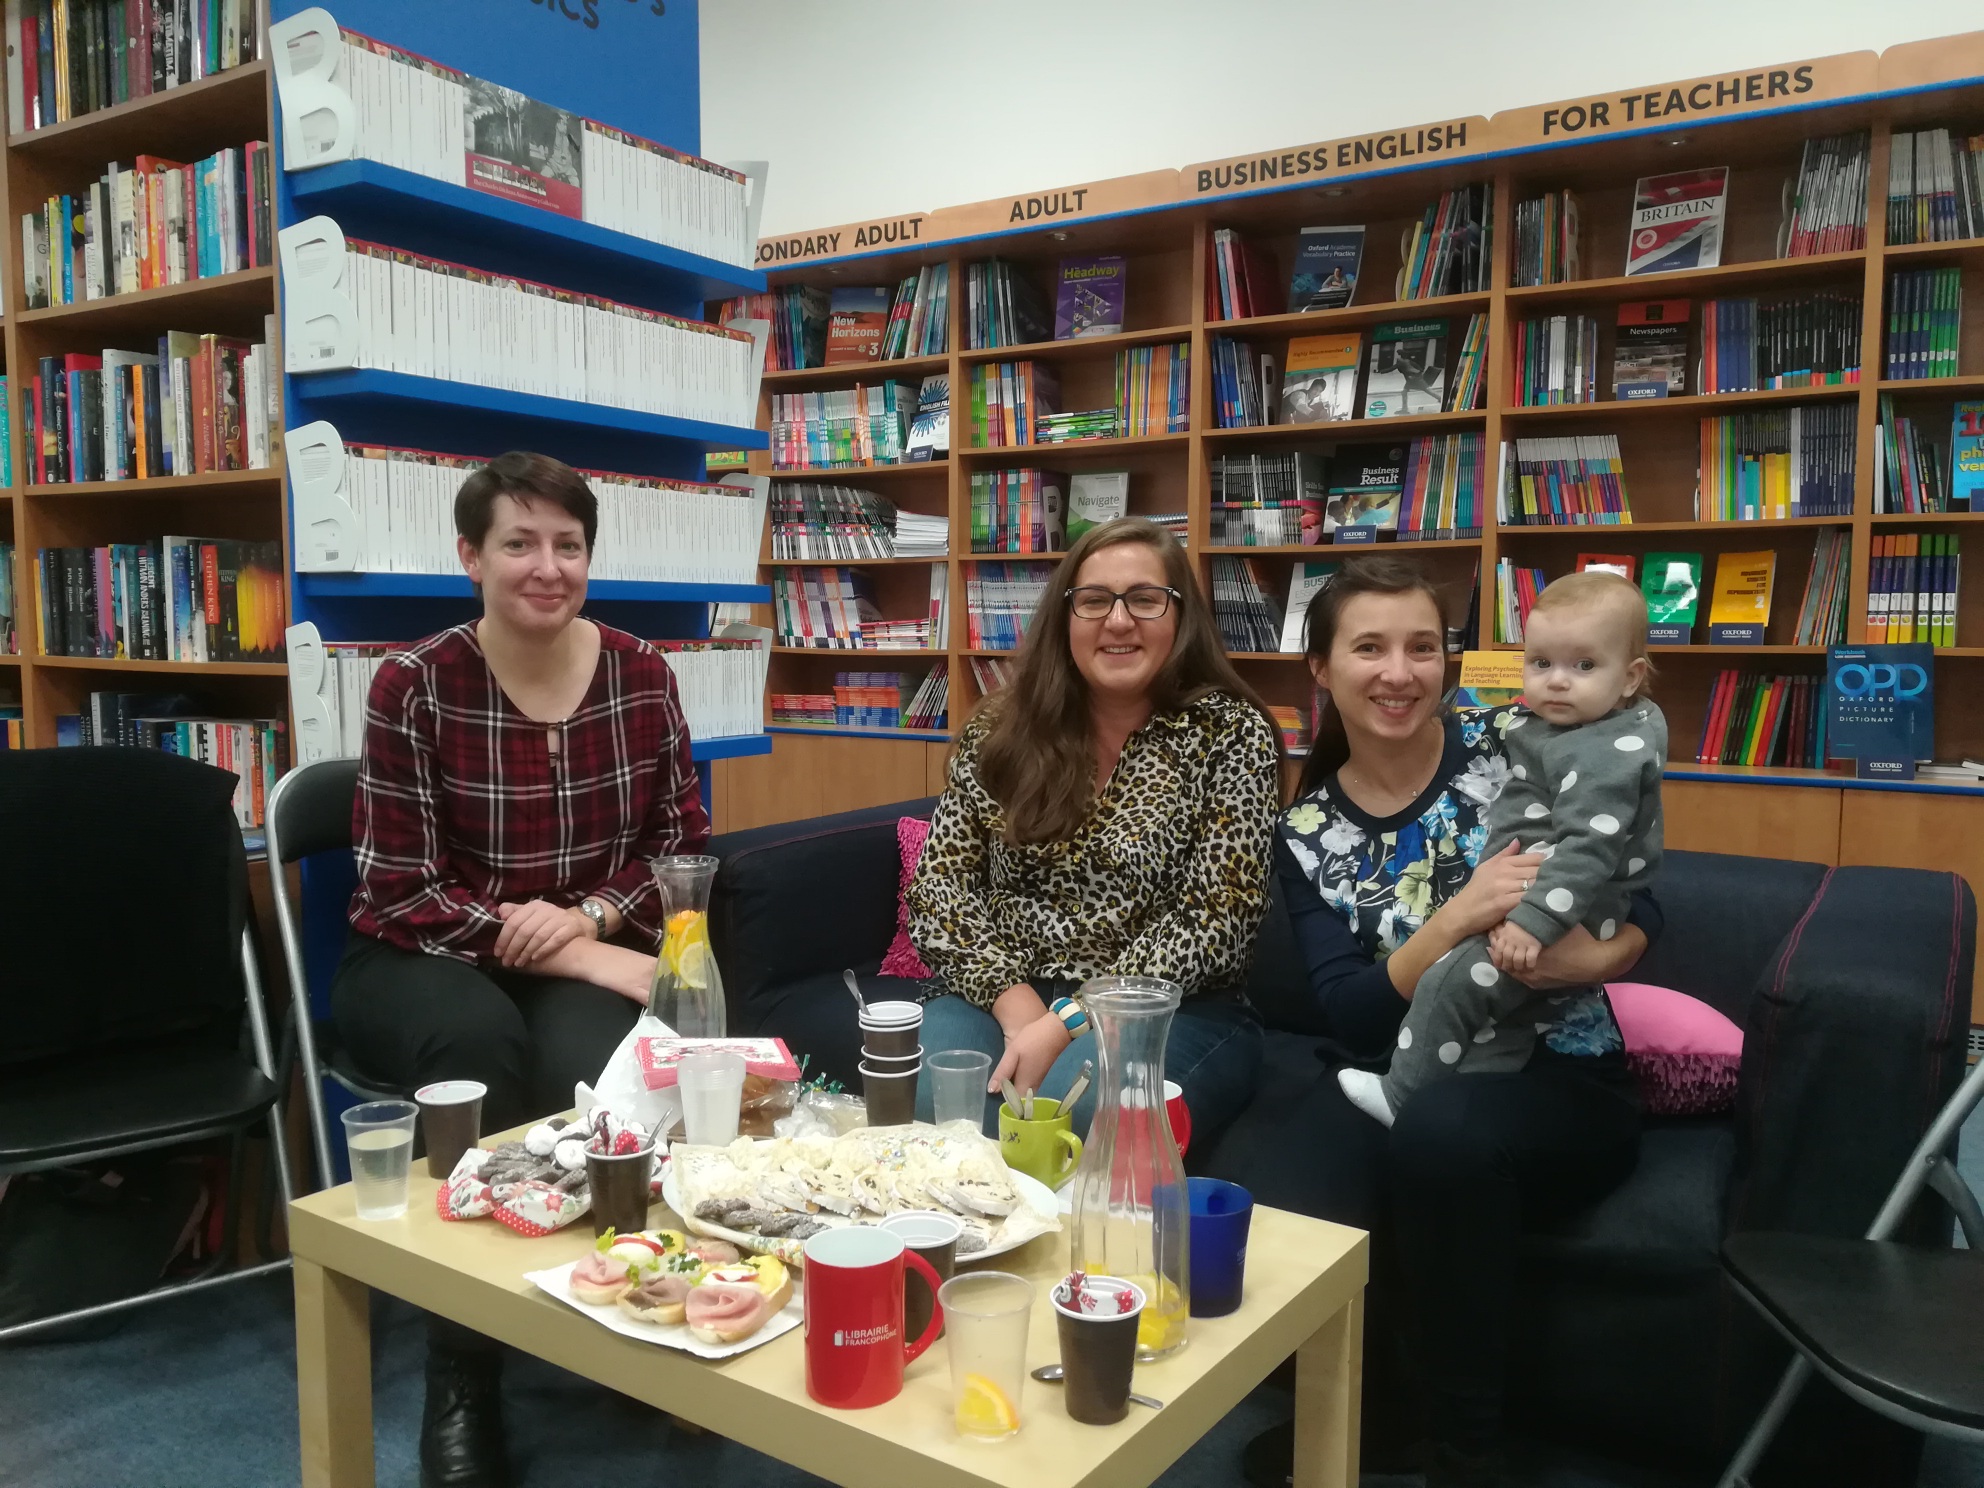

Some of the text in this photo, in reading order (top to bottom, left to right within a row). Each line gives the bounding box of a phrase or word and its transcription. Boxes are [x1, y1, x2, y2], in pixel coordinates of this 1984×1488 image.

[1543, 66, 1814, 135] FOR TEACHERS
[1197, 122, 1467, 192] BUSINESS ENGLISH
[1009, 189, 1088, 222] ADULT
[1641, 199, 1715, 222] BRITAIN
[754, 217, 923, 264] CONDARY ADULT
[1064, 264, 1119, 279] Headway
[833, 316, 856, 326] New
[831, 327, 880, 338] Horizons
[1394, 322, 1441, 335] Business
[1630, 327, 1677, 335] Newspapers
[869, 342, 879, 356] 3
[1362, 467, 1399, 475] Business
[1360, 474, 1399, 486] Result
[1078, 495, 1120, 508] Navigate
[205, 554, 215, 622] STEPHEN KING
[1304, 575, 1332, 588] BUSI
[1754, 595, 1765, 609] 2
[1835, 663, 1928, 698] OPD
[845, 1323, 889, 1339] LIBRAIRIE
[845, 1329, 897, 1346] FRANCOPHONE
